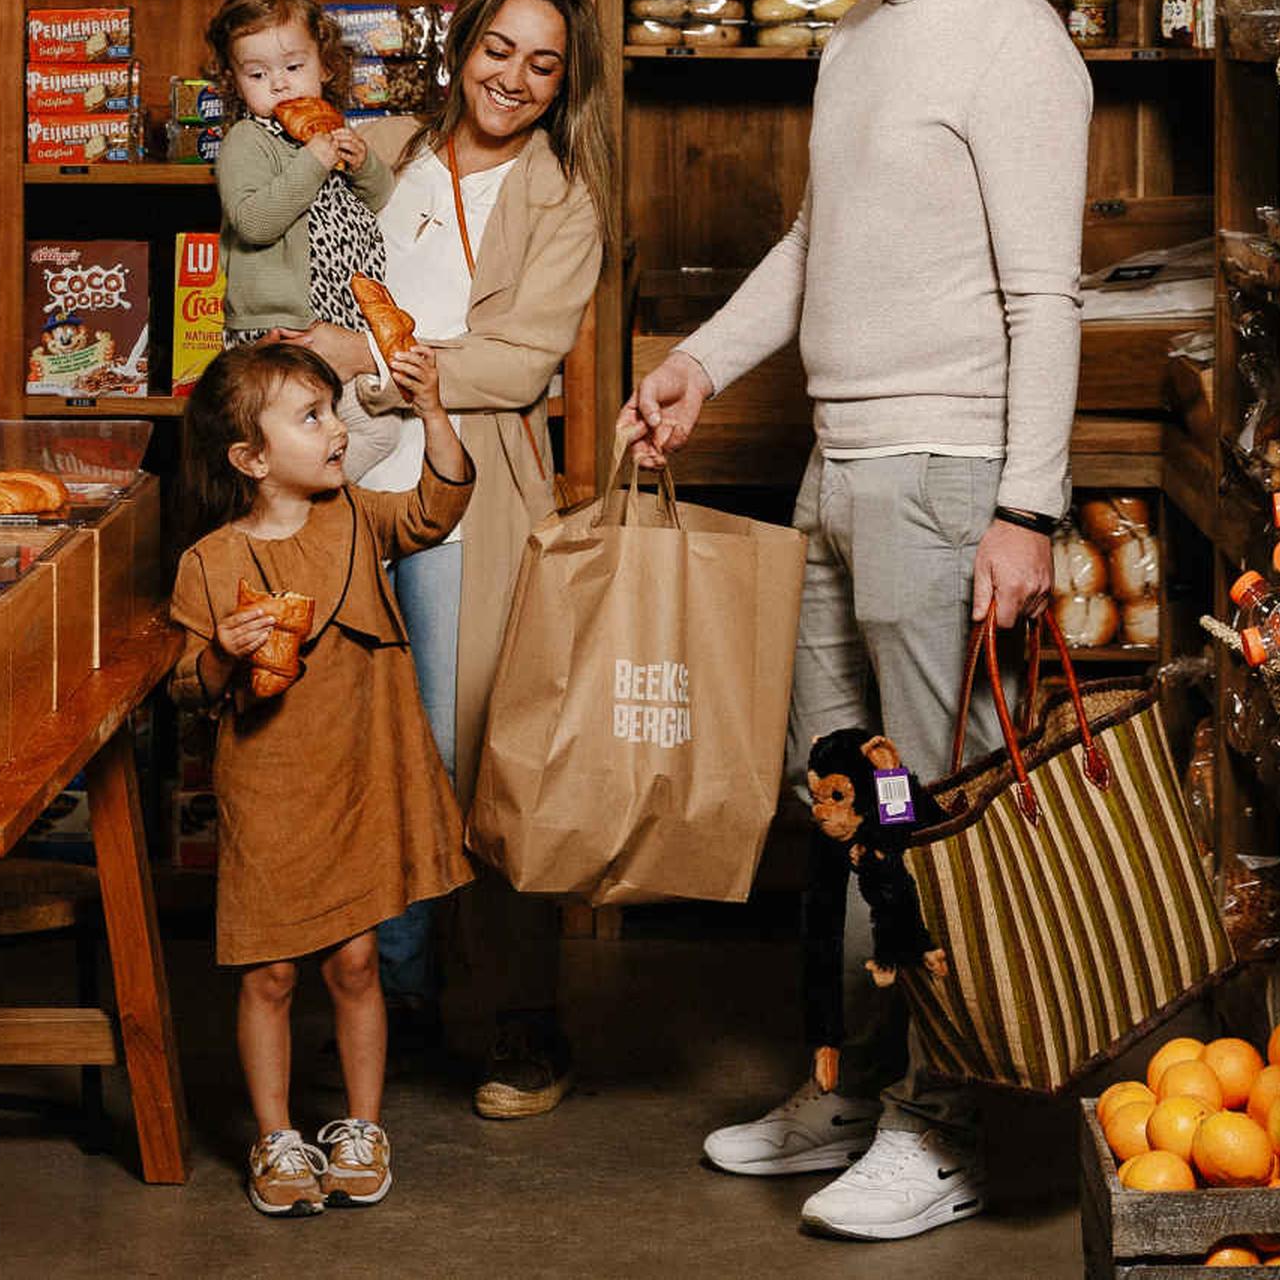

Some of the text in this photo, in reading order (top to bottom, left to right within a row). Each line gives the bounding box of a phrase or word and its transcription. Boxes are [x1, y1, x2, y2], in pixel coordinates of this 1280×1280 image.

[187, 243, 214, 273] LU
[49, 271, 123, 296] COCO
[613, 659, 689, 703] BEEKS
[613, 704, 692, 749] BERG
